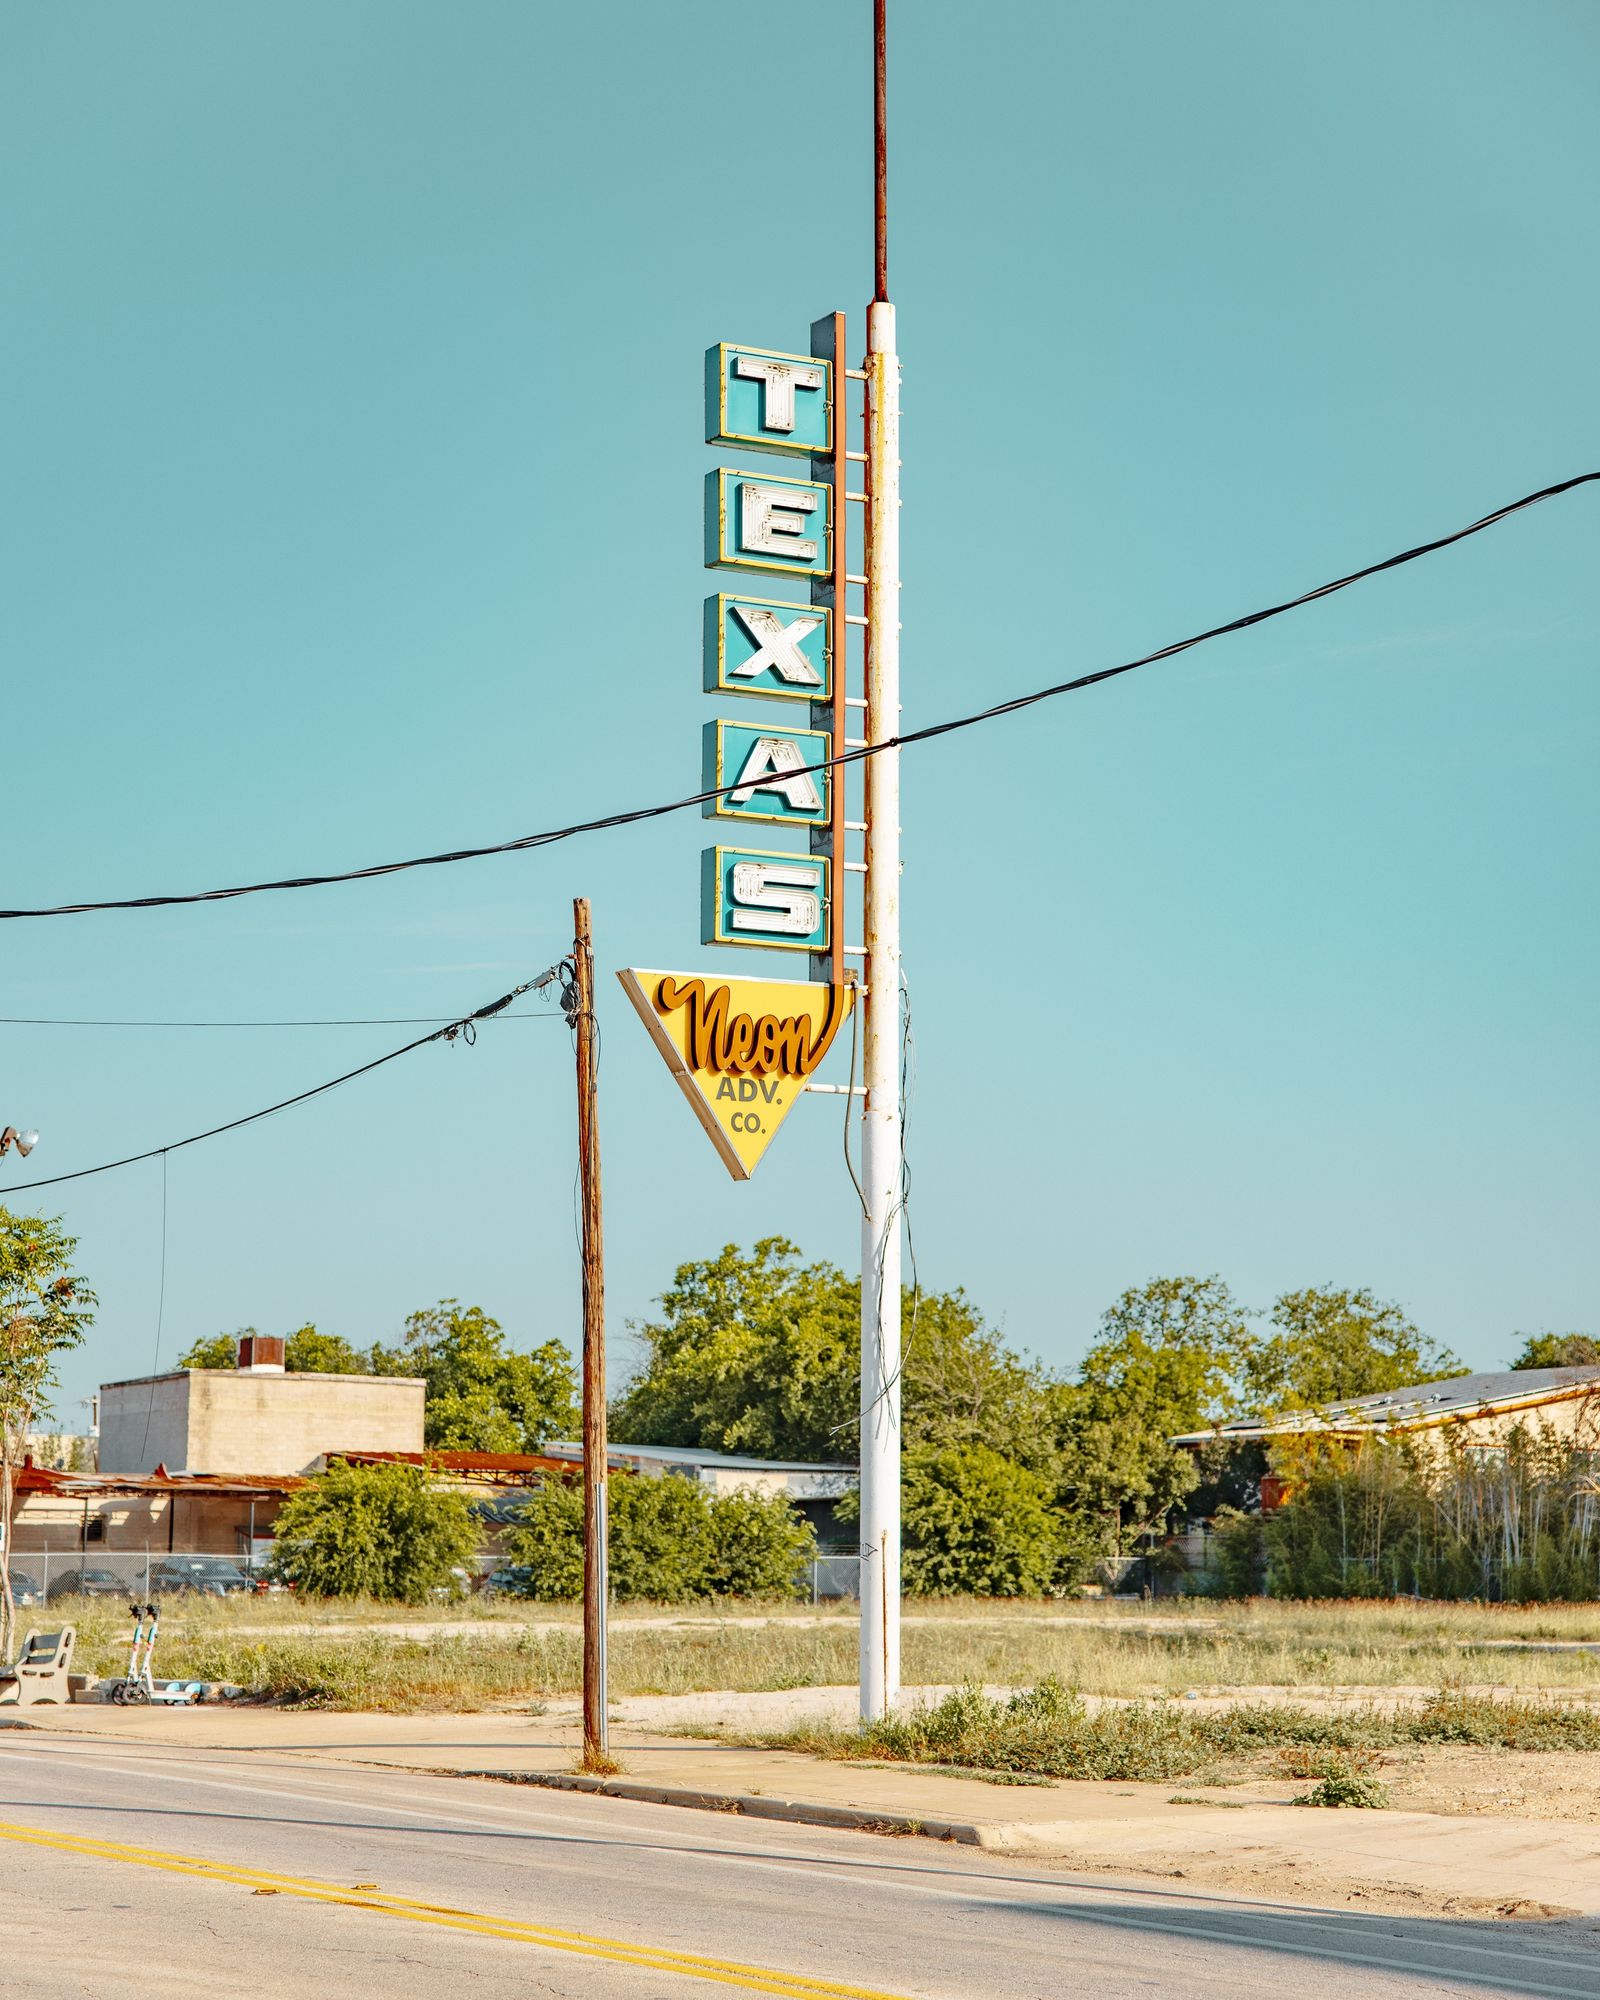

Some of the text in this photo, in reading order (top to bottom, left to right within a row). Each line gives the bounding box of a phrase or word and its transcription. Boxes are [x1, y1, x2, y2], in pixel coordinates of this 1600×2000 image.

[727, 356, 824, 935] TEXAS
[658, 976, 844, 1075] Neon
[716, 1076, 782, 1105] ADV.
[730, 1111, 766, 1134] CO.
